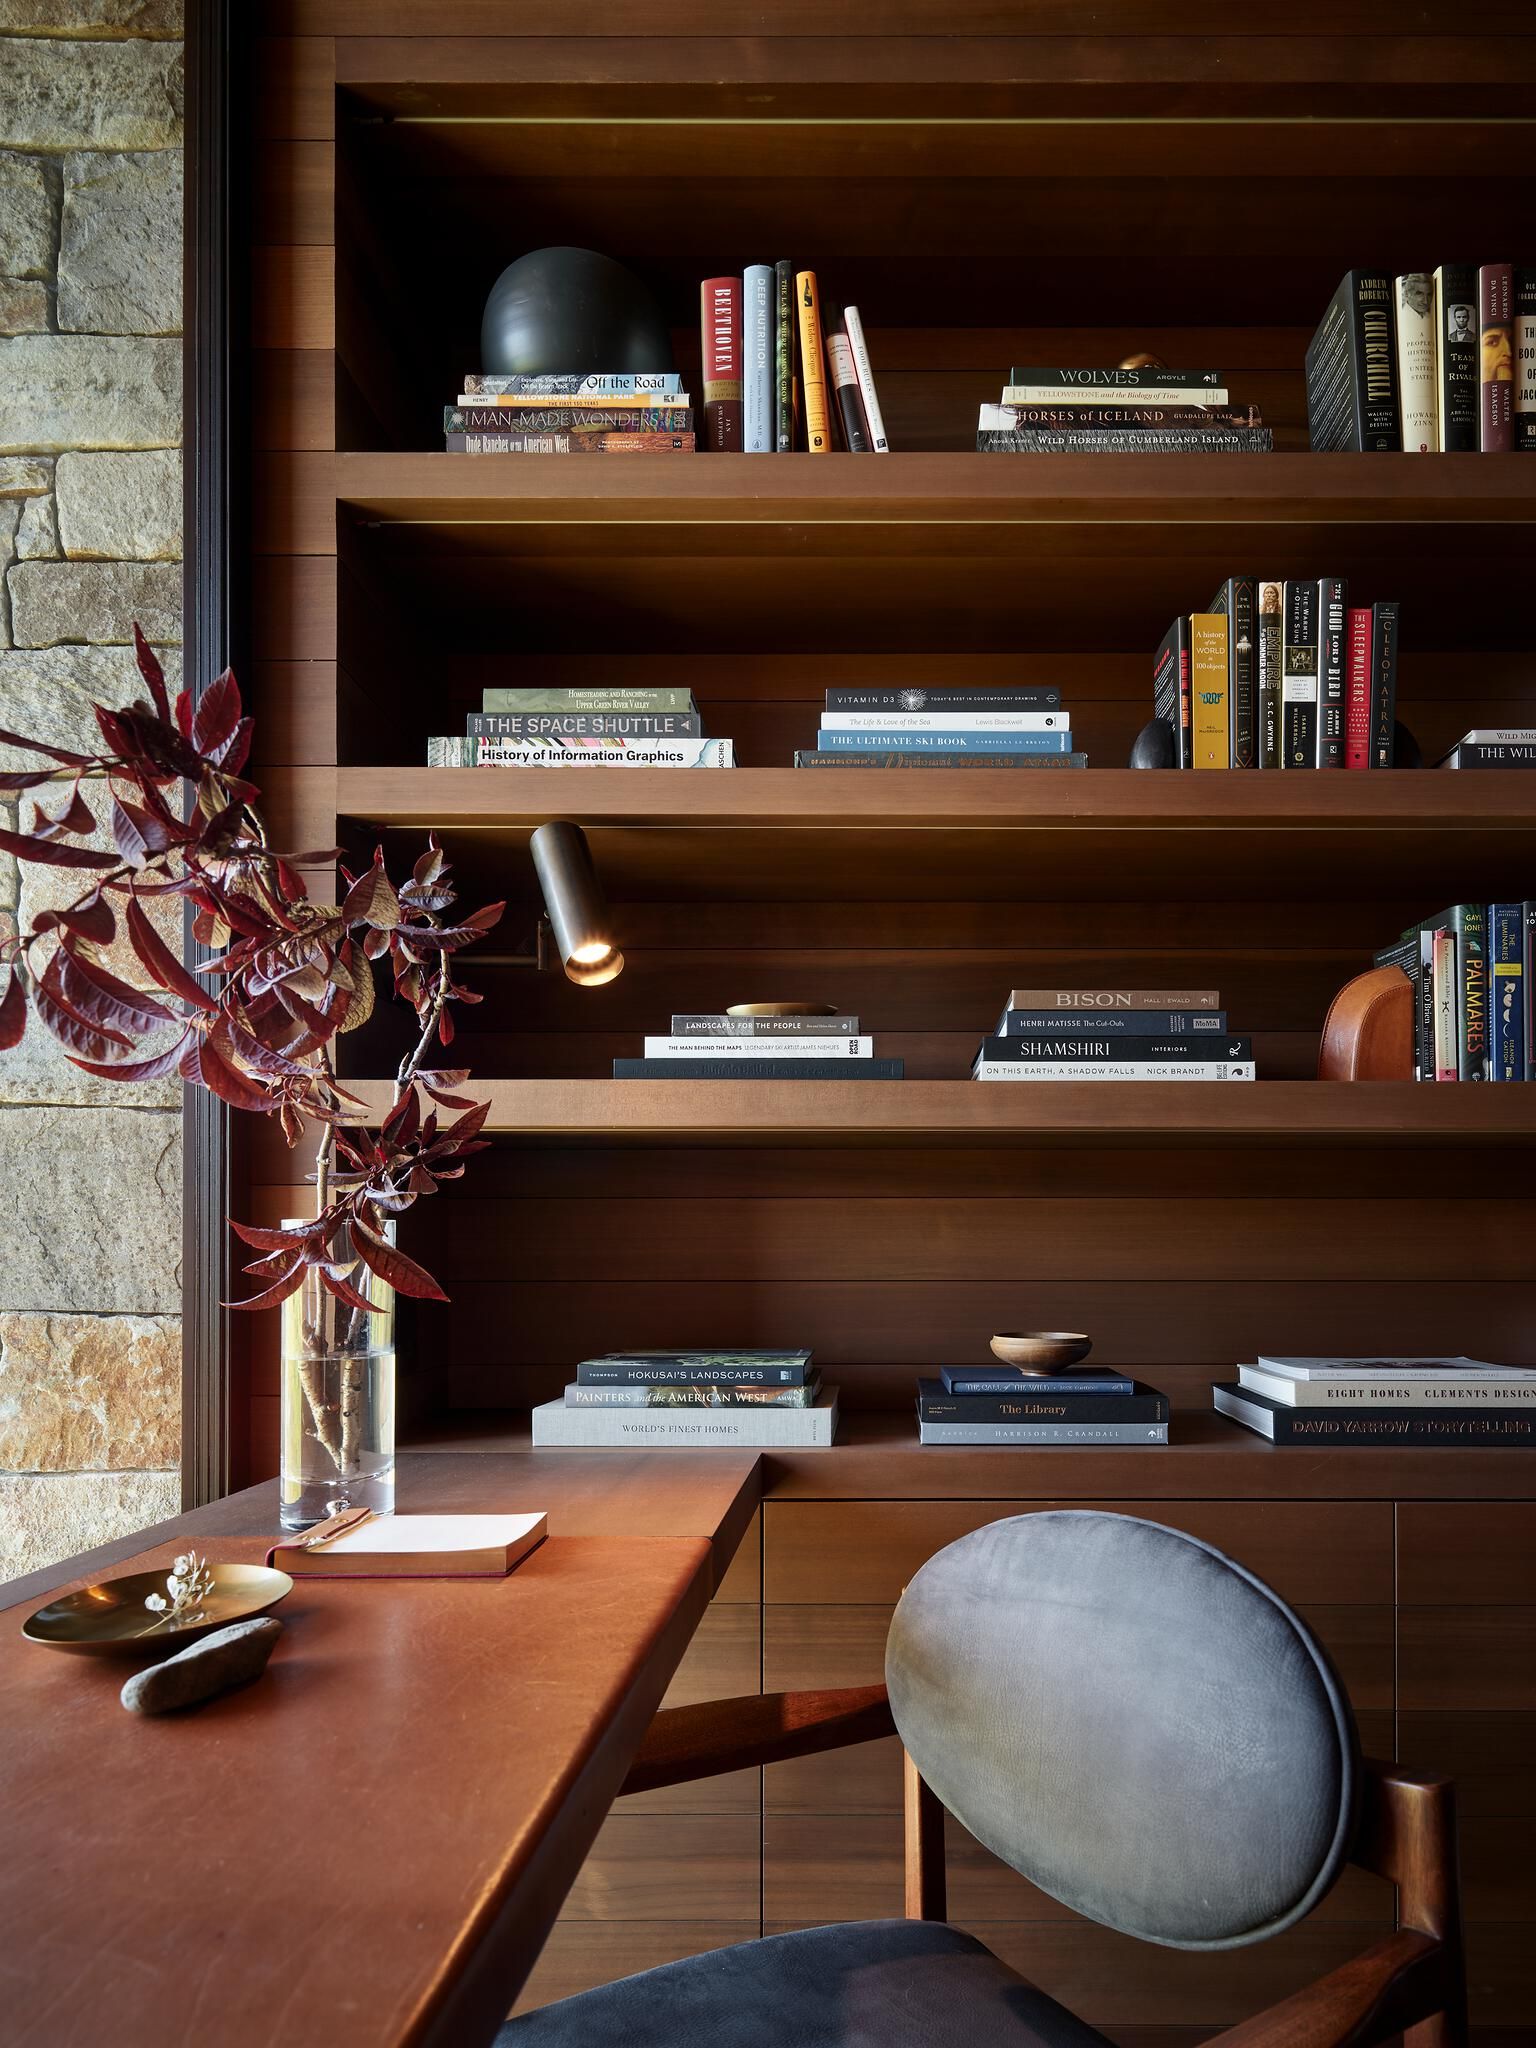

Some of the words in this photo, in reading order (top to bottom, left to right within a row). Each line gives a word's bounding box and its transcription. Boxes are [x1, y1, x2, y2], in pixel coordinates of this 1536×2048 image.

[757, 278, 767, 306] DEEP
[1360, 280, 1387, 289] ANDREW
[1490, 280, 1498, 293] DA
[1359, 290, 1390, 300] ROBERTS
[1490, 295, 1498, 316] VINCI
[714, 288, 733, 372] BEETHOVEN
[808, 321, 817, 344] Widow
[758, 310, 768, 369] NUTRITION
[808, 347, 819, 376] Clicquot
[1363, 310, 1392, 402] CHURCHILL
[857, 346, 868, 367] FOOD
[863, 368, 873, 393] RULES
[587, 376, 606, 389] Off
[611, 376, 631, 389] the
[634, 376, 665, 389] Road
[1060, 370, 1140, 385] WOLVES
[1037, 390, 1099, 399] YELLOWSTONE
[1100, 390, 1115, 399] and
[1115, 390, 1127, 399] the
[1127, 391, 1153, 401] Biology
[1162, 391, 1180, 399] Time
[1490, 384, 1498, 427] ISAACSON
[571, 411, 658, 427] WONDERS
[674, 411, 687, 428] DK
[1017, 411, 1075, 421] HORSES
[1080, 411, 1094, 421] of
[1098, 411, 1165, 421] ICELAND
[717, 405, 725, 446] SWAFFORD
[465, 436, 482, 453] Dude
[482, 436, 509, 453] Ranches
[523, 436, 553, 453] American
[554, 435, 571, 453] West
[1112, 436, 1126, 445] OF
[1302, 608, 1310, 641] WARMTH
[1328, 603, 1344, 631] GOOD
[1354, 614, 1366, 622] THE
[1196, 632, 1204, 640] A
[1205, 631, 1227, 642] history
[1196, 647, 1227, 655] WORLD
[1259, 640, 1267, 667] SUMMER
[1331, 634, 1340, 663] LORD
[1266, 626, 1281, 691] EMPIRE
[1353, 623, 1366, 704] SLEEPWALKERS
[1196, 662, 1208, 670] 100
[1208, 662, 1227, 672] objects
[1328, 668, 1341, 698] BIRD
[1380, 621, 1393, 734] CLEOPATRA
[609, 690, 620, 698] AND
[485, 717, 523, 733] THE
[527, 717, 587, 734] SPACE
[591, 717, 675, 733] SHUTTLE
[849, 718, 861, 726] The
[862, 718, 874, 727] Life
[884, 718, 898, 726] Love
[908, 718, 918, 726] the
[919, 718, 931, 726] Sea
[831, 736, 854, 746] THE
[857, 736, 912, 746] ULTIMATE
[916, 737, 936, 746] SKI
[937, 737, 968, 746] BOOK
[1266, 720, 1275, 753] GWYNNE
[481, 749, 530, 763] History
[532, 749, 546, 761] of
[549, 749, 623, 761] Information
[626, 750, 684, 764] Graphics
[1477, 746, 1505, 758] THE
[1510, 746, 1536, 758] WIL
[1501, 919, 1509, 961] LUMINARIES
[1422, 976, 1431, 993] Tim
[1055, 993, 1133, 1007] BISON
[1466, 958, 1485, 1054] PALMARES
[1423, 994, 1433, 1024] O'Brien
[686, 1022, 736, 1030] LANDSCAPES
[738, 1022, 753, 1030] FOR
[755, 1022, 771, 1030] THE
[773, 1022, 802, 1030] PEOPLE
[1020, 1020, 1046, 1028] HENRI
[1047, 1020, 1081, 1028] MATISSE
[1083, 1019, 1095, 1028] The
[1194, 1020, 1219, 1028] MoMA
[1019, 1042, 1111, 1057] SHAMSHIRI
[1508, 1038, 1516, 1065] ELEANOR
[1024, 1068, 1056, 1076] EARTH,
[628, 1371, 686, 1380] HOKUSAI'S
[690, 1371, 765, 1380] LANDSCAPES
[966, 1383, 981, 1391] THE
[981, 1383, 1002, 1391] CALL
[1013, 1383, 1027, 1391] THE
[1327, 1389, 1364, 1398] EIGHT
[1370, 1389, 1411, 1398] HOMES
[1424, 1389, 1489, 1398] CLEMENTS
[1494, 1389, 1536, 1398] DESIGN
[650, 1392, 666, 1402] the
[999, 1404, 1022, 1414] The
[1025, 1404, 1067, 1416] Library
[621, 1425, 666, 1433] WORLD'S
[668, 1425, 703, 1433] FINEST
[703, 1425, 740, 1433] HOMES
[1292, 1420, 1341, 1433] DAVID
[1343, 1420, 1411, 1433] YARROW
[1413, 1420, 1532, 1433] STORYTELLING
